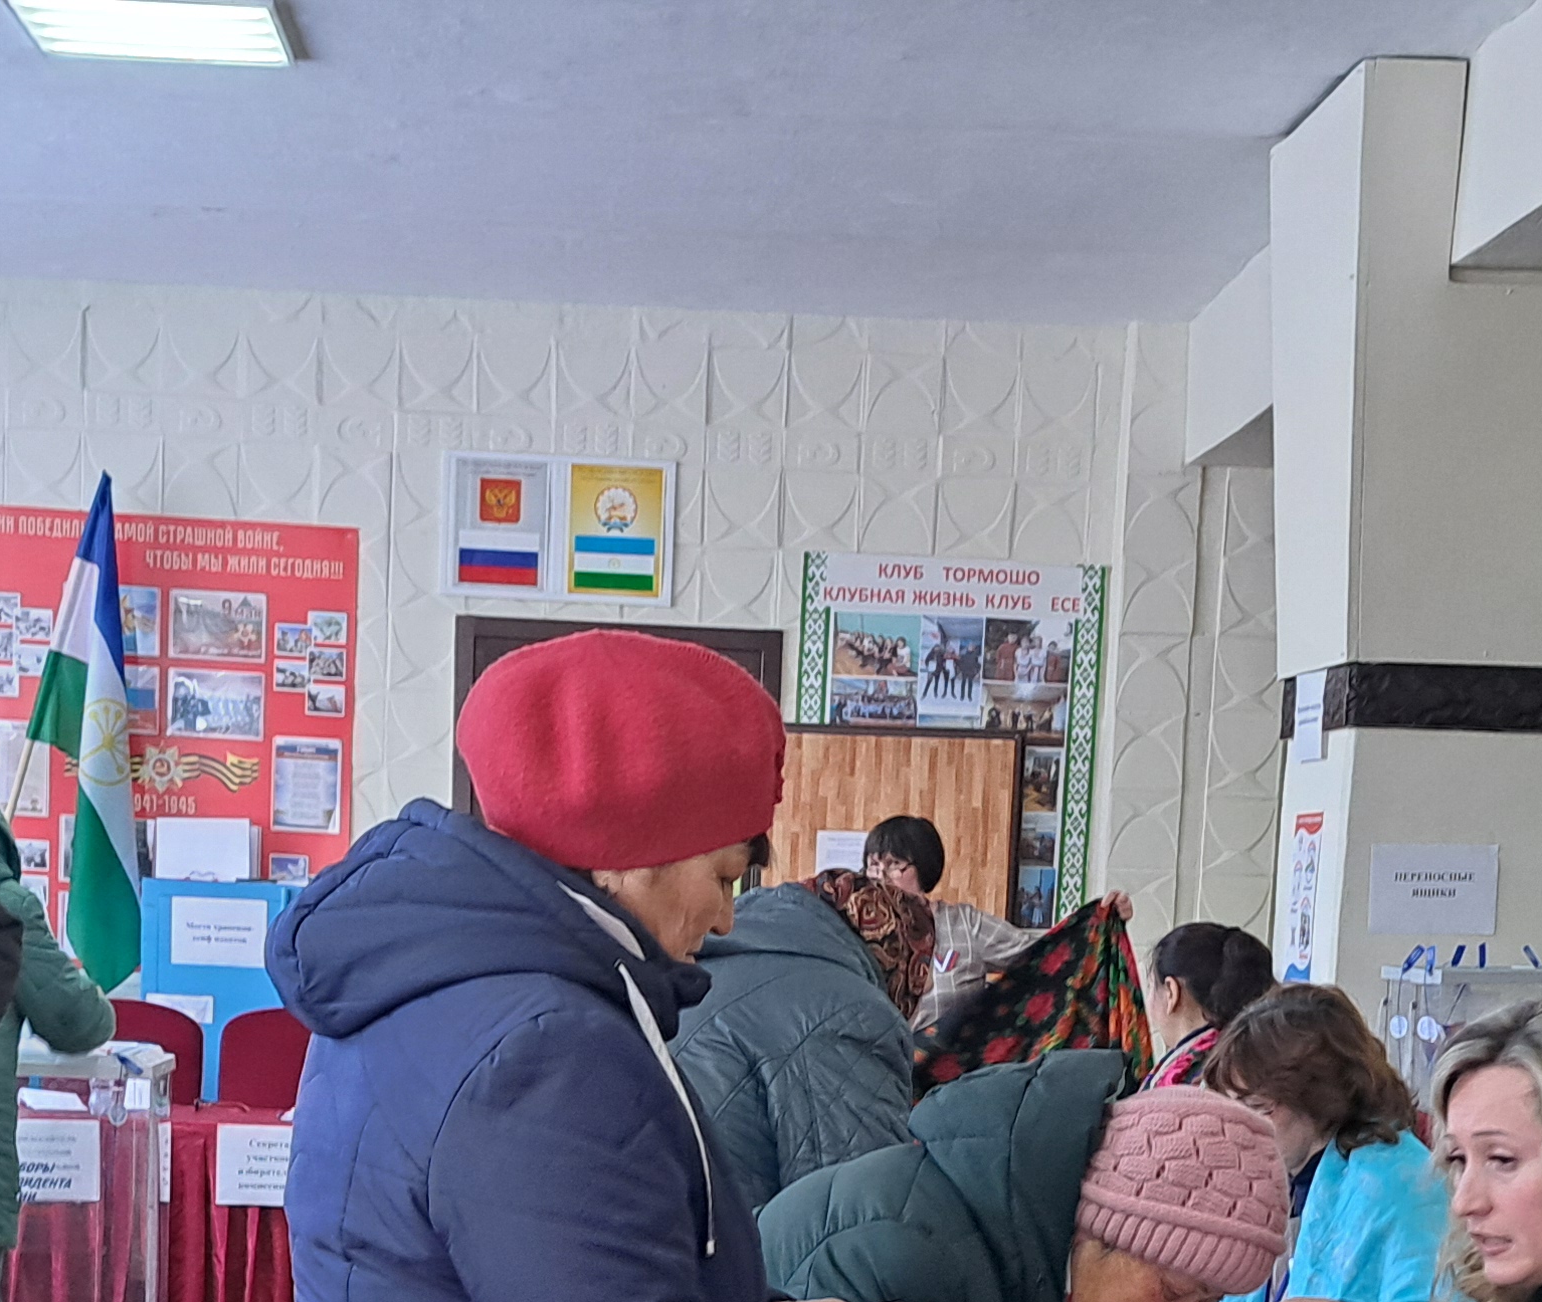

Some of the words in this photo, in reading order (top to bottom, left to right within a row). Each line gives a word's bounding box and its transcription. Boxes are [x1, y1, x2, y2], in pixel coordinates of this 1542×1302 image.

[114, 521, 155, 543] АМОЙ
[158, 522, 234, 547] СТРАШНОЙ
[145, 549, 193, 572] ЧТОБЫ
[196, 552, 223, 574] МЫ
[226, 553, 267, 575] ЖИЛИ
[878, 563, 925, 580] КЛУБ
[941, 566, 1041, 586] ТОРМОШО
[823, 586, 906, 605] КЛУБНАЯ
[912, 589, 976, 608] ЖИЗНЬ
[985, 593, 1033, 612] КЛУБ
[134, 793, 196, 815] 941-1945
[1394, 871, 1476, 882] ПЕРЕНОСНЫЕ
[19, 1161, 56, 1174] БОРЫ
